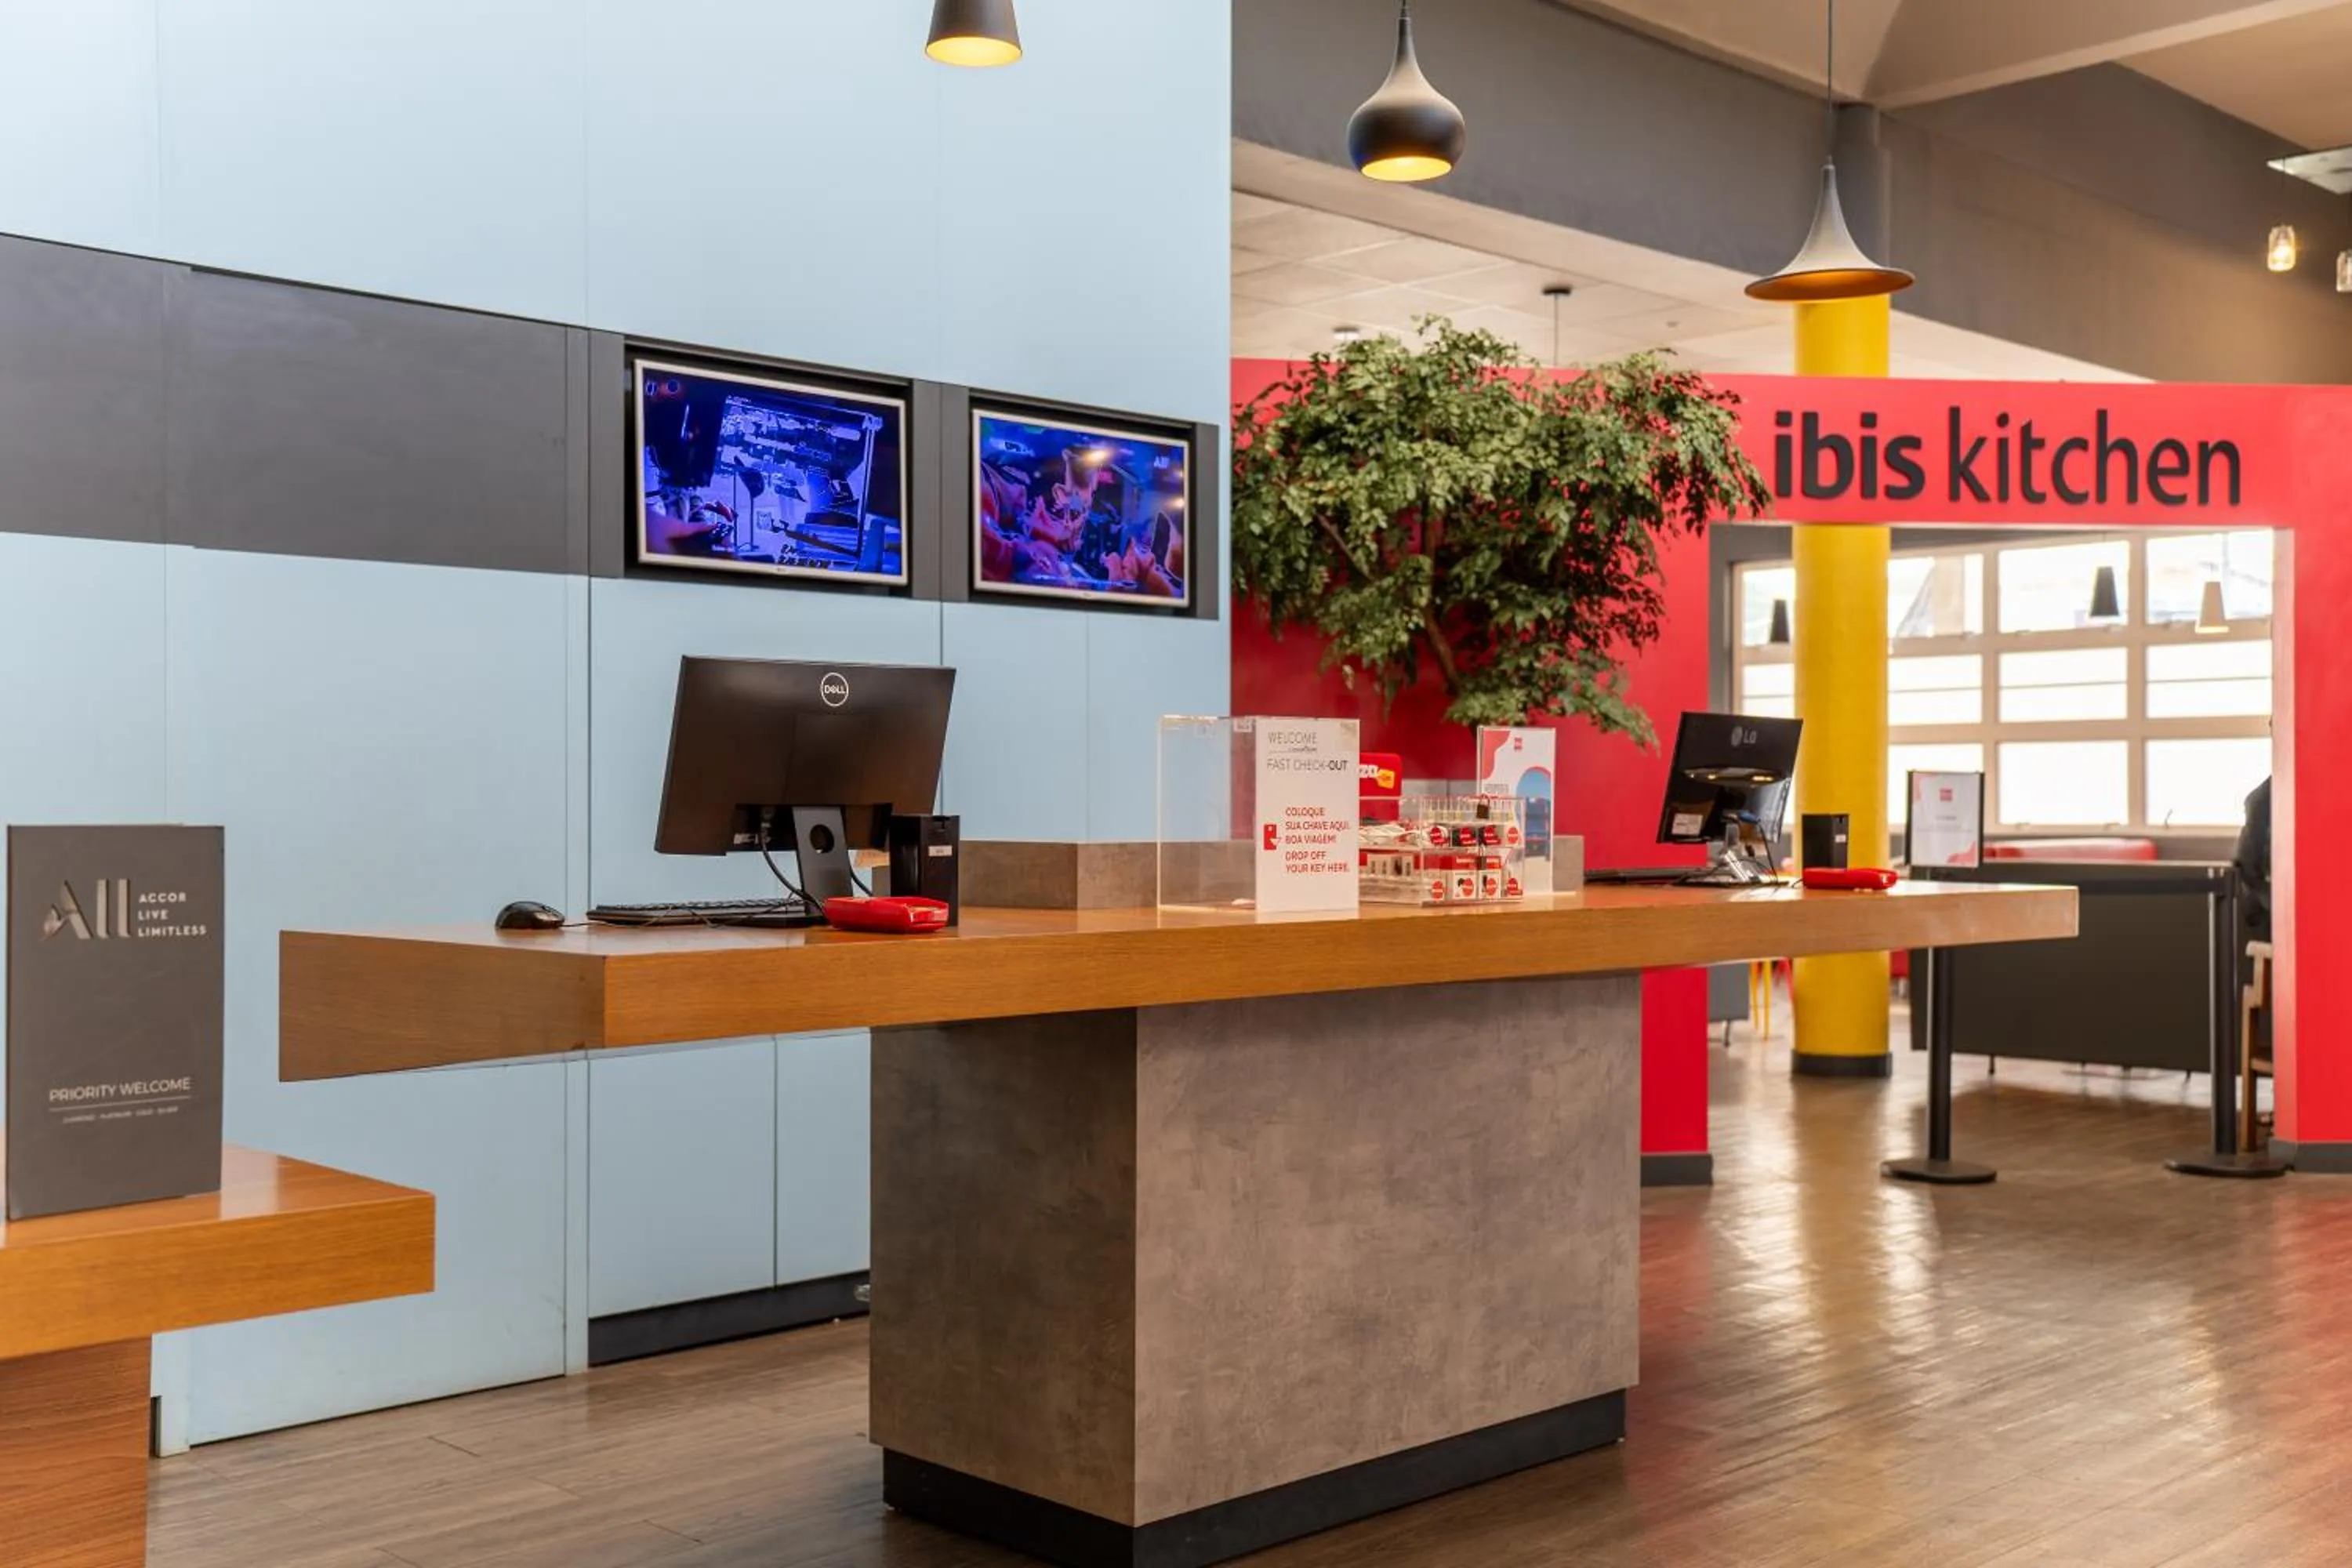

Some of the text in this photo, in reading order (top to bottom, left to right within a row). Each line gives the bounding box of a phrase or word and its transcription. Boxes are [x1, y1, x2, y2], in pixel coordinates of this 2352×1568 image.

[1774, 405, 2241, 507] ibis kitchen
[824, 684, 846, 694] DELL
[1268, 731, 1318, 745] WELCOME
[1267, 758, 1290, 771] FAST
[1285, 807, 1326, 818] COLOQUE
[1285, 835, 1302, 844] BOA
[1285, 851, 1327, 862] DROP OFF
[1285, 863, 1308, 873] YOUR
[1310, 863, 1326, 873] KEY
[138, 892, 187, 904] ACCOR
[137, 909, 169, 921] LIVE
[137, 924, 208, 938] LIMITLESS
[49, 1076, 191, 1102] PRIORITY WELCOME
